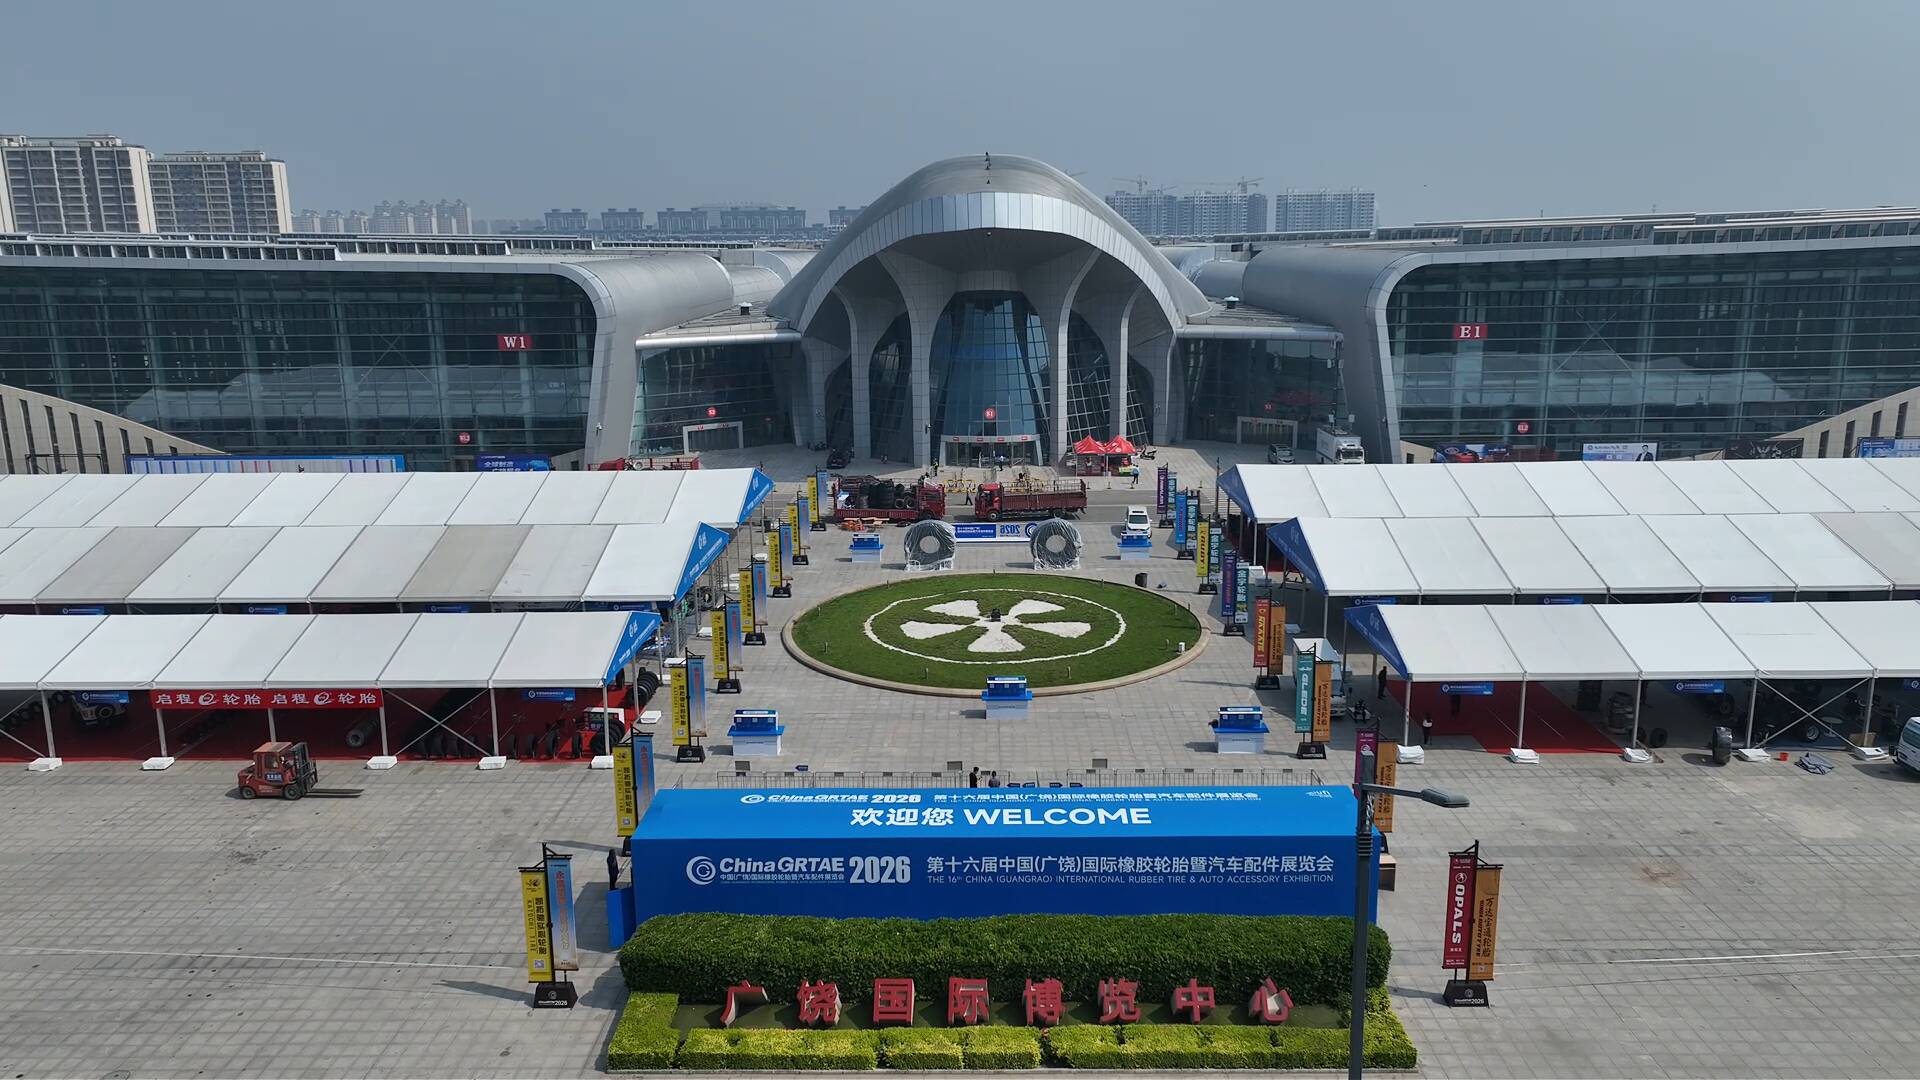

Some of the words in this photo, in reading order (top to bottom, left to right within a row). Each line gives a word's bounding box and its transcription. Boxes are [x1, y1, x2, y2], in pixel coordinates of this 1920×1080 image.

[1459, 325, 1480, 338] E1
[503, 336, 526, 349] W1
[155, 693, 194, 705] 启程
[223, 693, 261, 705] 轮胎
[271, 692, 309, 704] 启程
[338, 692, 377, 704] 轮胎
[871, 794, 921, 803] 2026
[850, 808, 954, 826] 欢迎您
[963, 808, 1152, 825] WELCOME
[849, 855, 911, 884] 2026
[926, 855, 1334, 874] 第十六届中国(广饶)国际橡胶轮胎暨汽车配件展览会
[996, 876, 1053, 884] (GUANGRAO)
[1128, 875, 1164, 883] RUBBER
[1167, 875, 1186, 883] TIRE
[1189, 875, 1196, 883] &
[1199, 875, 1224, 883] AUTO
[1227, 875, 1280, 883] ACCESSORY
[1283, 875, 1334, 883] EXHIBITION
[1452, 884, 1466, 945] OPALS
[722, 976, 1293, 1022] 广饶国际博览中心
